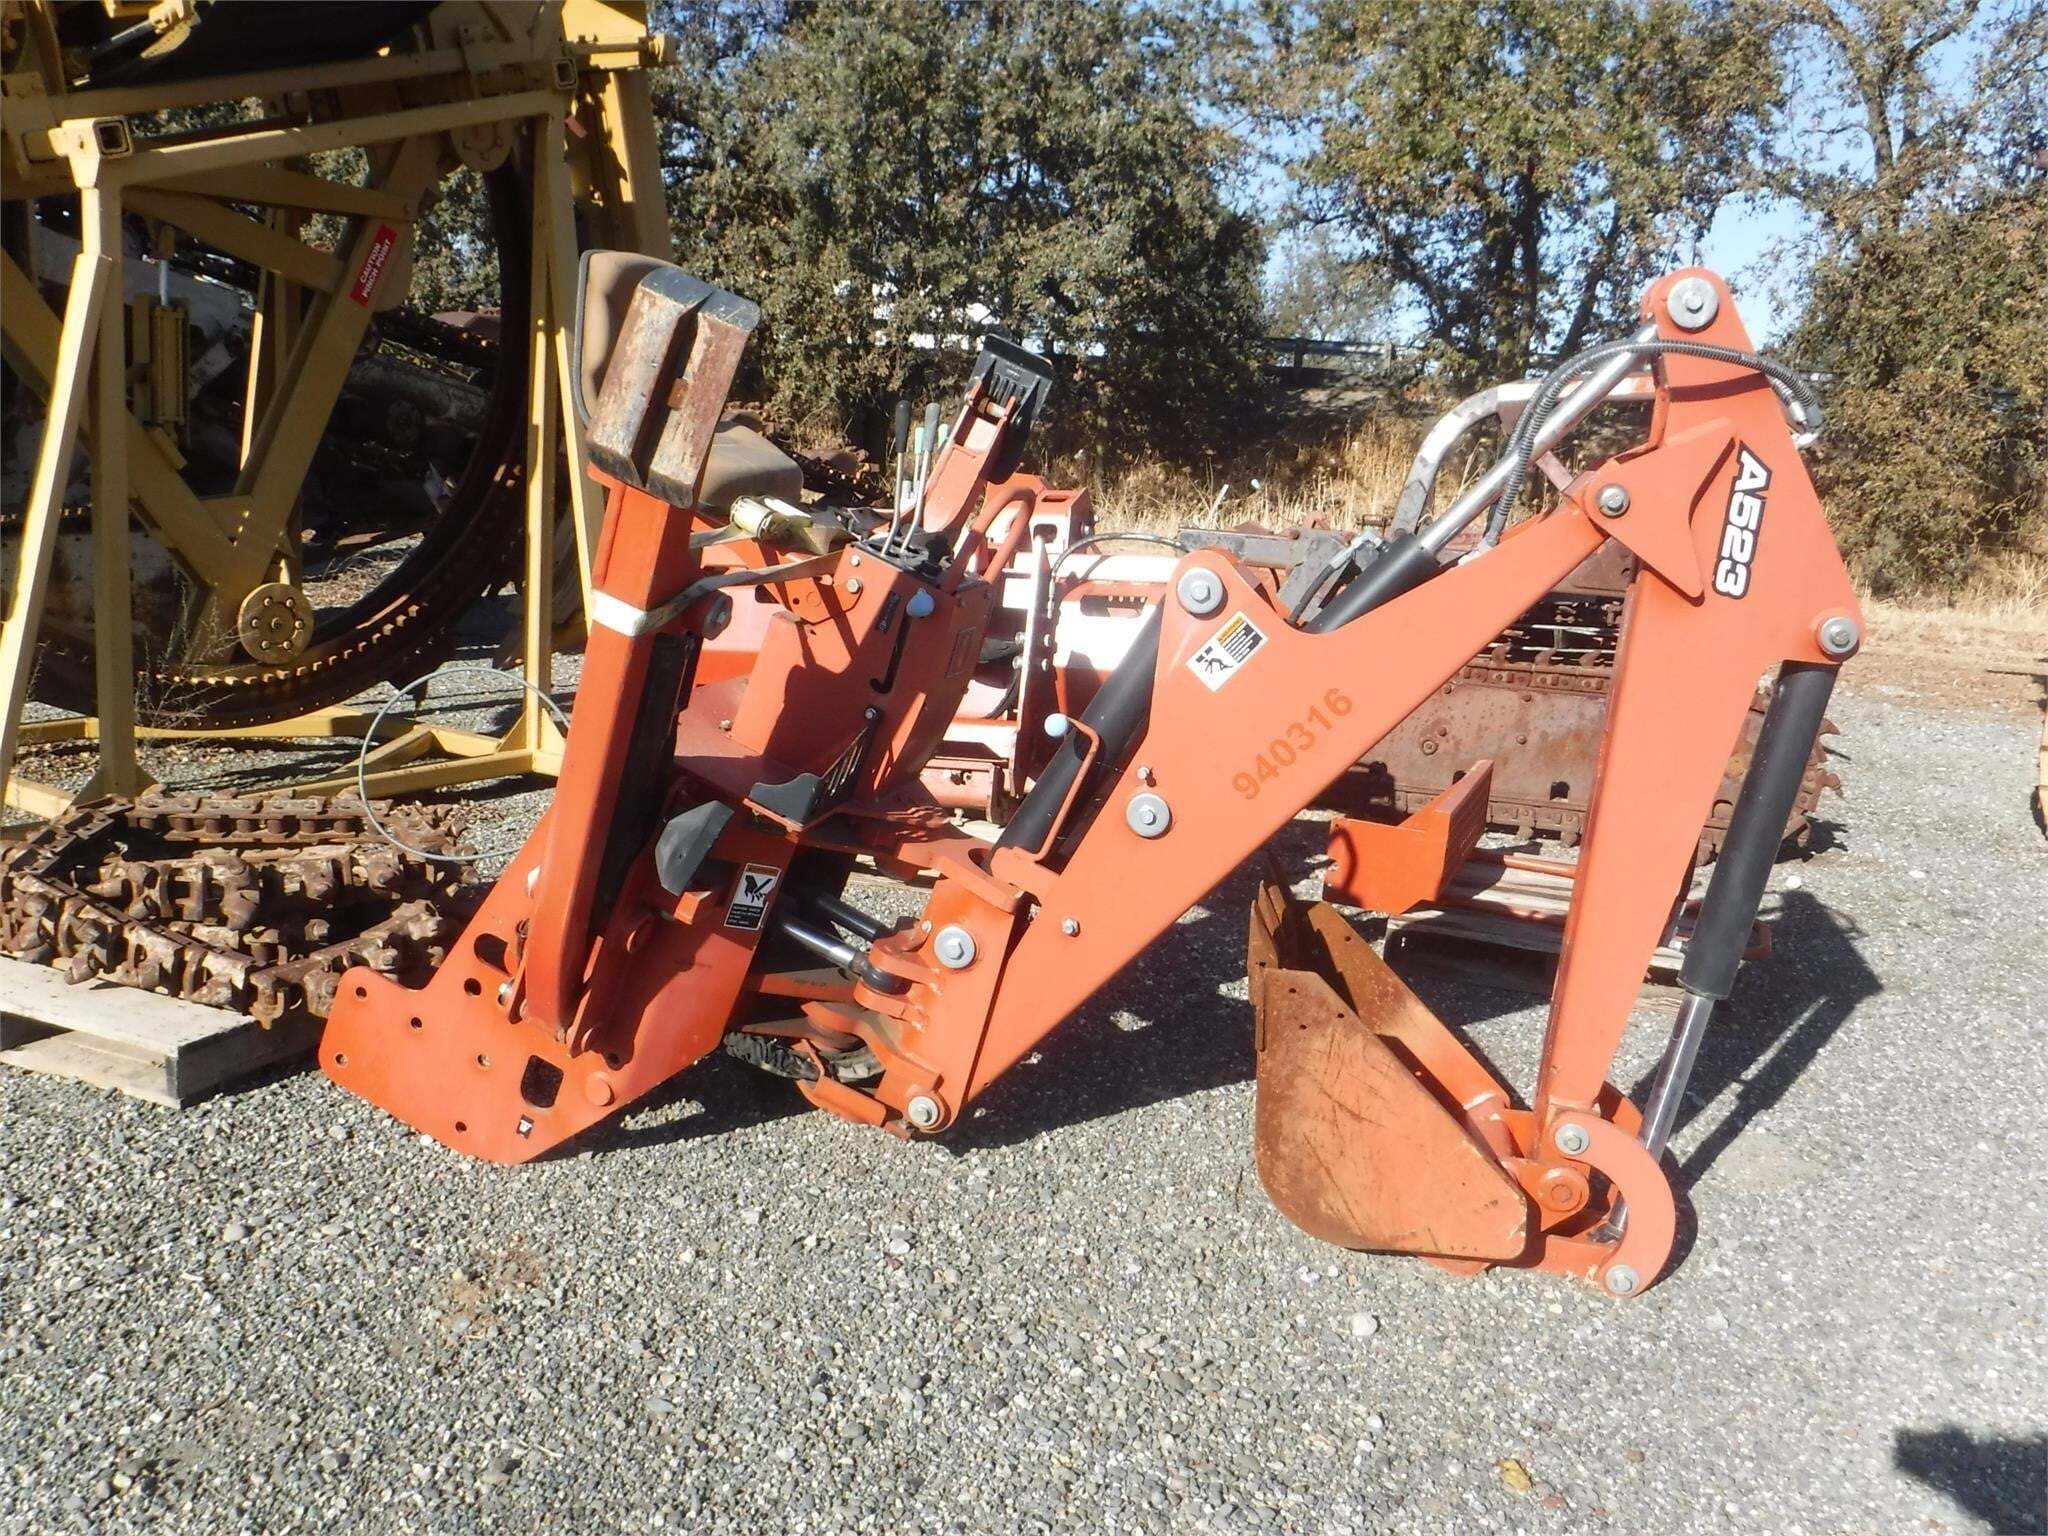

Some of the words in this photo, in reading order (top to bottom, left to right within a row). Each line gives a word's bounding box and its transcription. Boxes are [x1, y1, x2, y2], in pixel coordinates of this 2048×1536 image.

[360, 242, 381, 283] CAUTION
[362, 267, 378, 298] PINCH
[376, 238, 390, 267] POINT
[1713, 443, 1771, 599] A523
[1232, 687, 1353, 800] 940316
